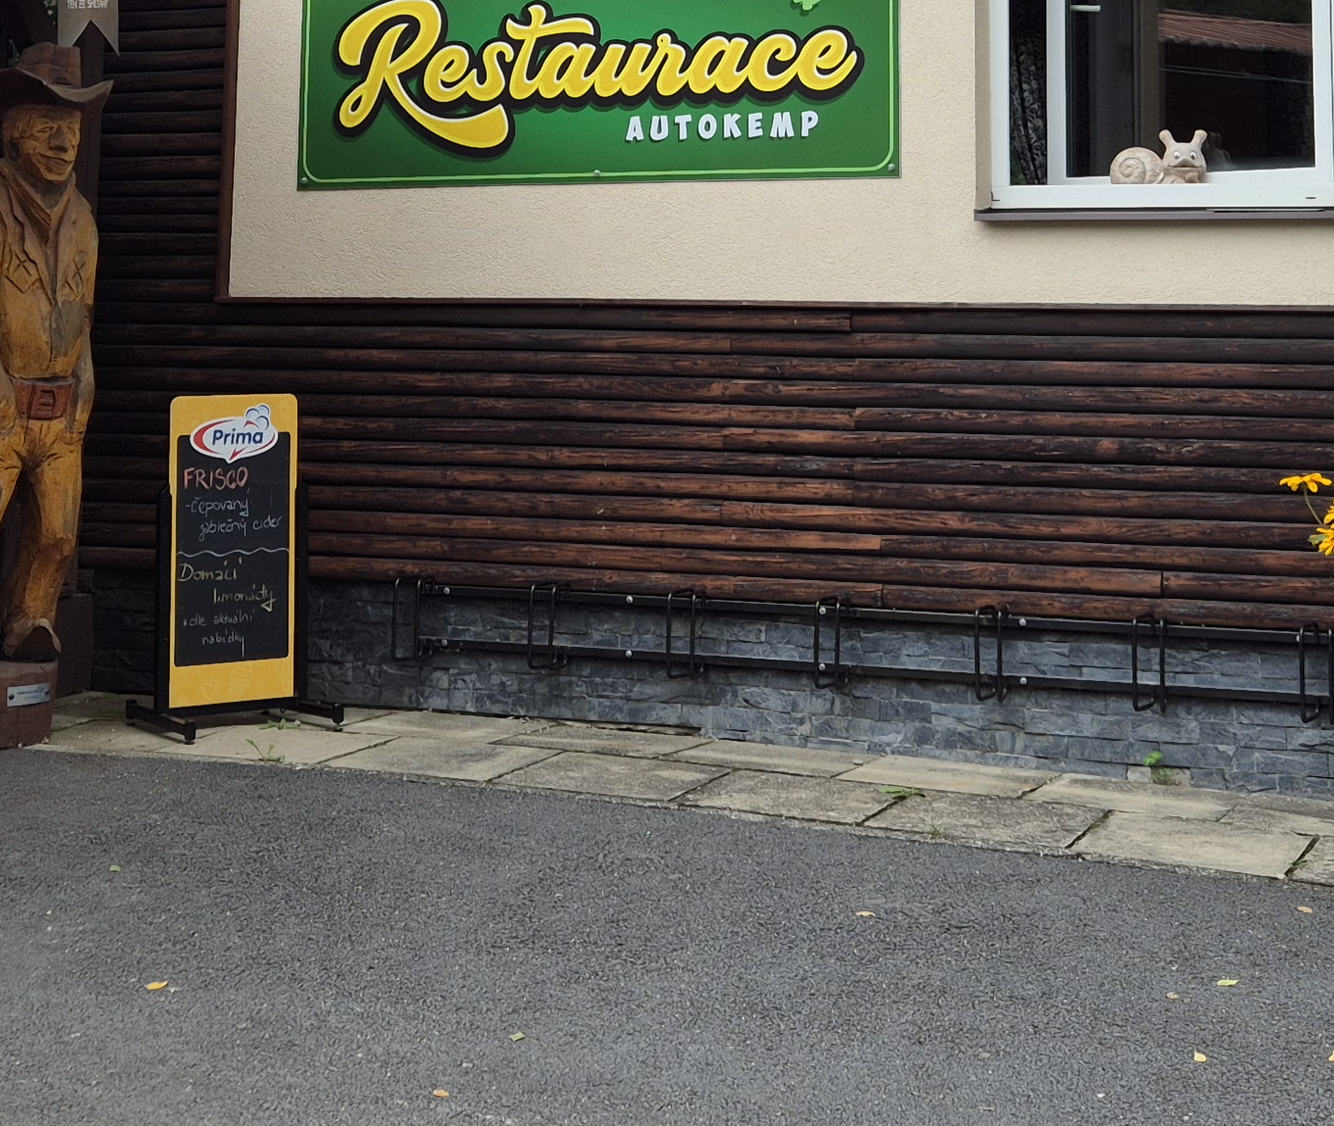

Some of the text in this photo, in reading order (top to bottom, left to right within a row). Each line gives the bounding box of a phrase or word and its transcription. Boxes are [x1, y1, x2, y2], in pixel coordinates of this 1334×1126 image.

[625, 110, 820, 142] AUTOKEMP
[212, 428, 264, 446] Prima
[183, 466, 249, 491] FRISCO
[252, 515, 282, 530] cider
[177, 557, 242, 582] Domácí
[202, 628, 245, 658] nabídky
